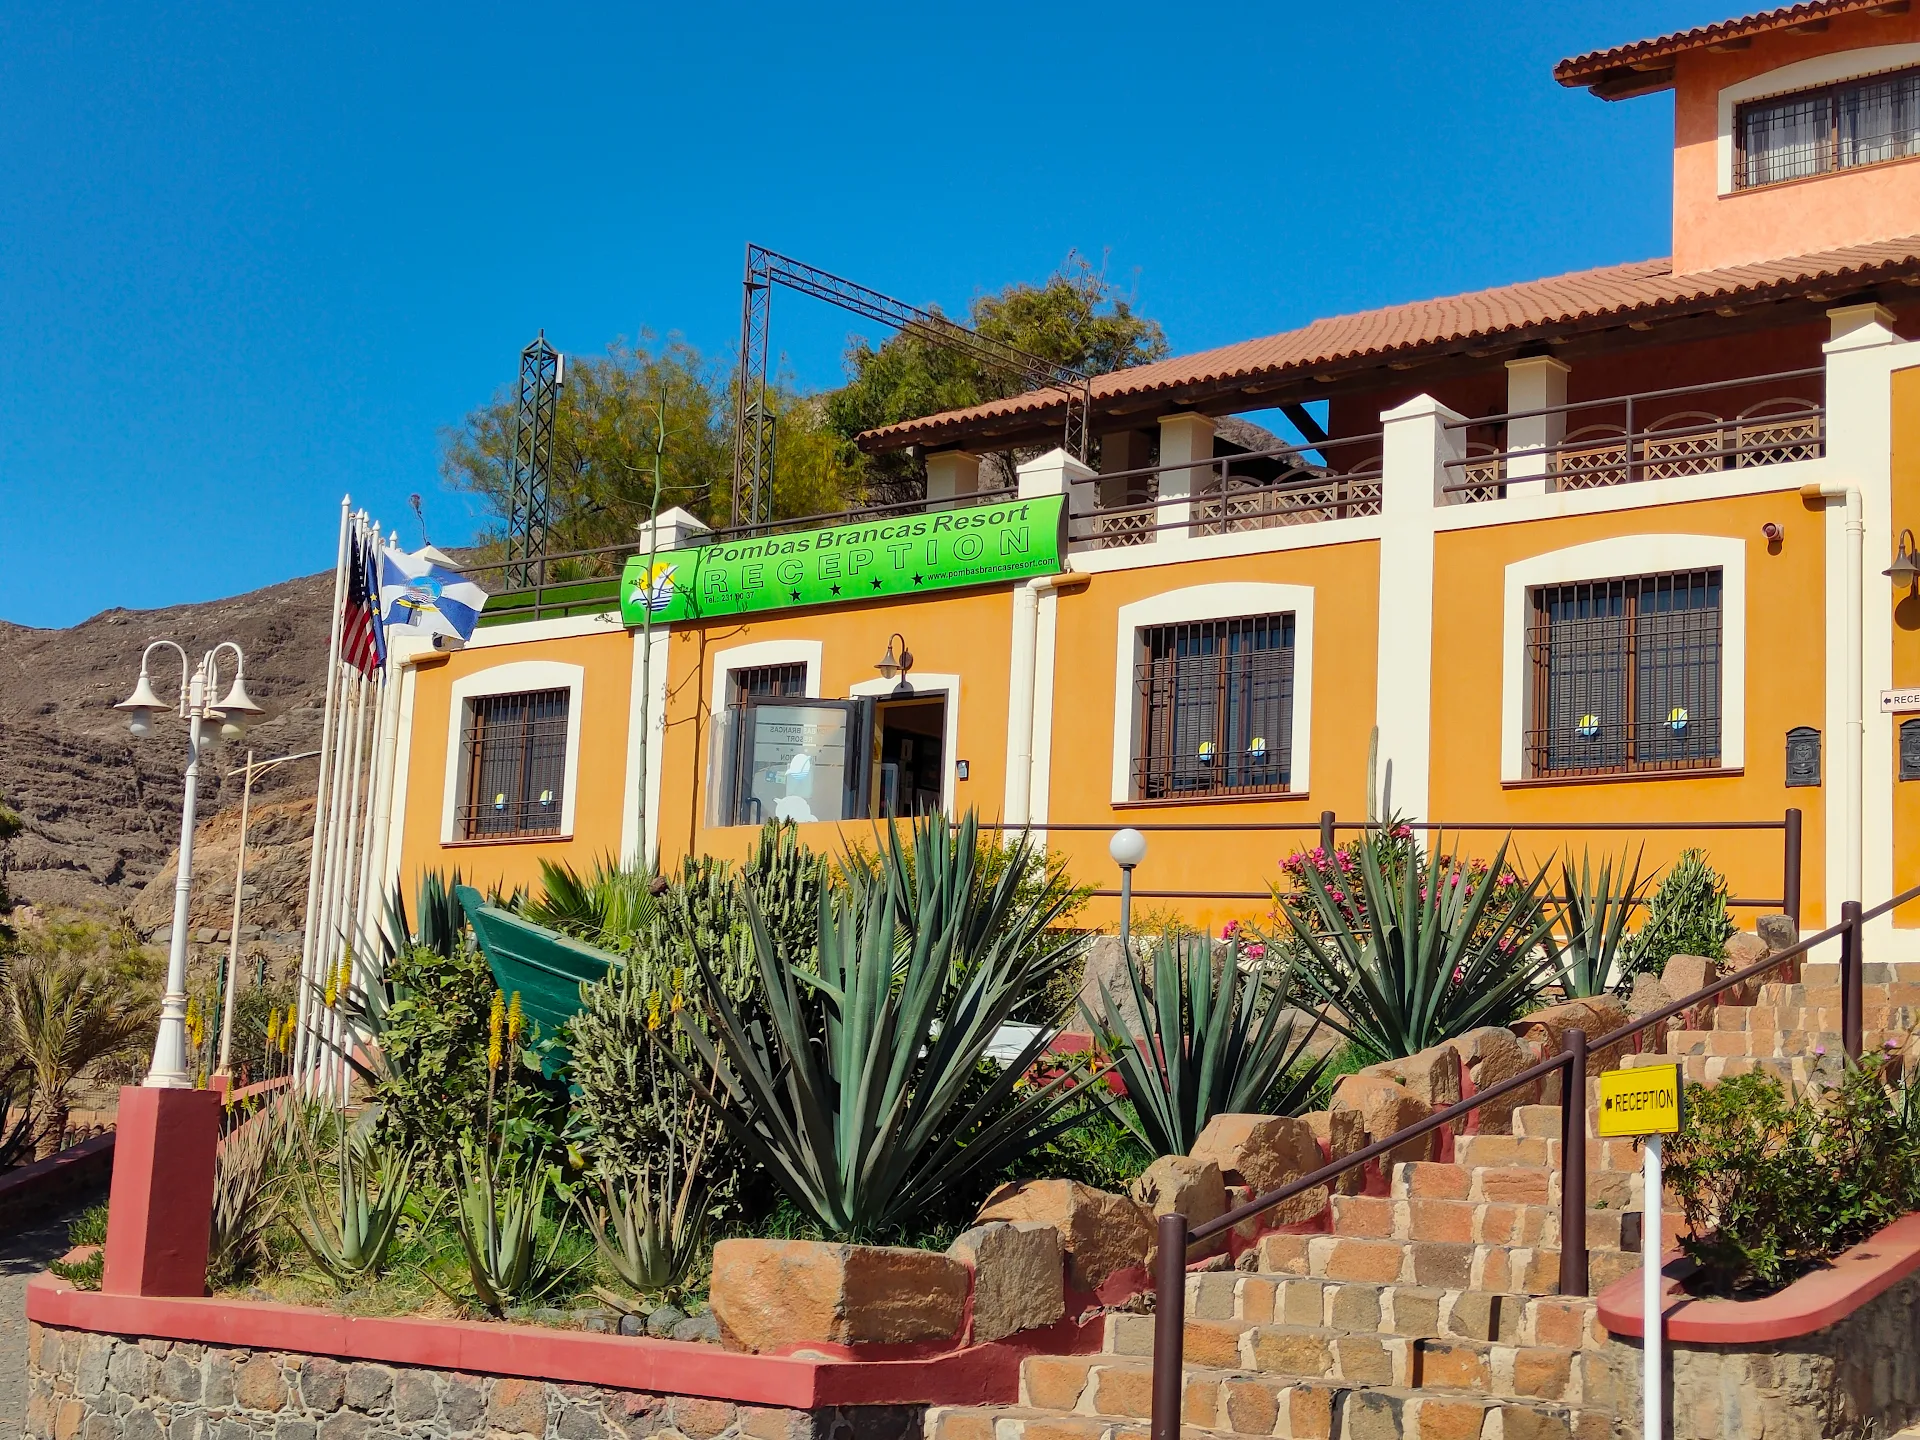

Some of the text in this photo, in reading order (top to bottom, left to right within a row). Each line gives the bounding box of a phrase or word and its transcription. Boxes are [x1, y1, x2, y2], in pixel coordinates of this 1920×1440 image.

[706, 504, 1030, 565] Pombas Brancas Resort
[703, 526, 1030, 595] RECEPTION
[927, 557, 1055, 581] www.pombasbrancasresort.com
[746, 591, 754, 599] 37
[1893, 694, 1920, 705] RECE
[1615, 1088, 1674, 1113] RECEPTION
